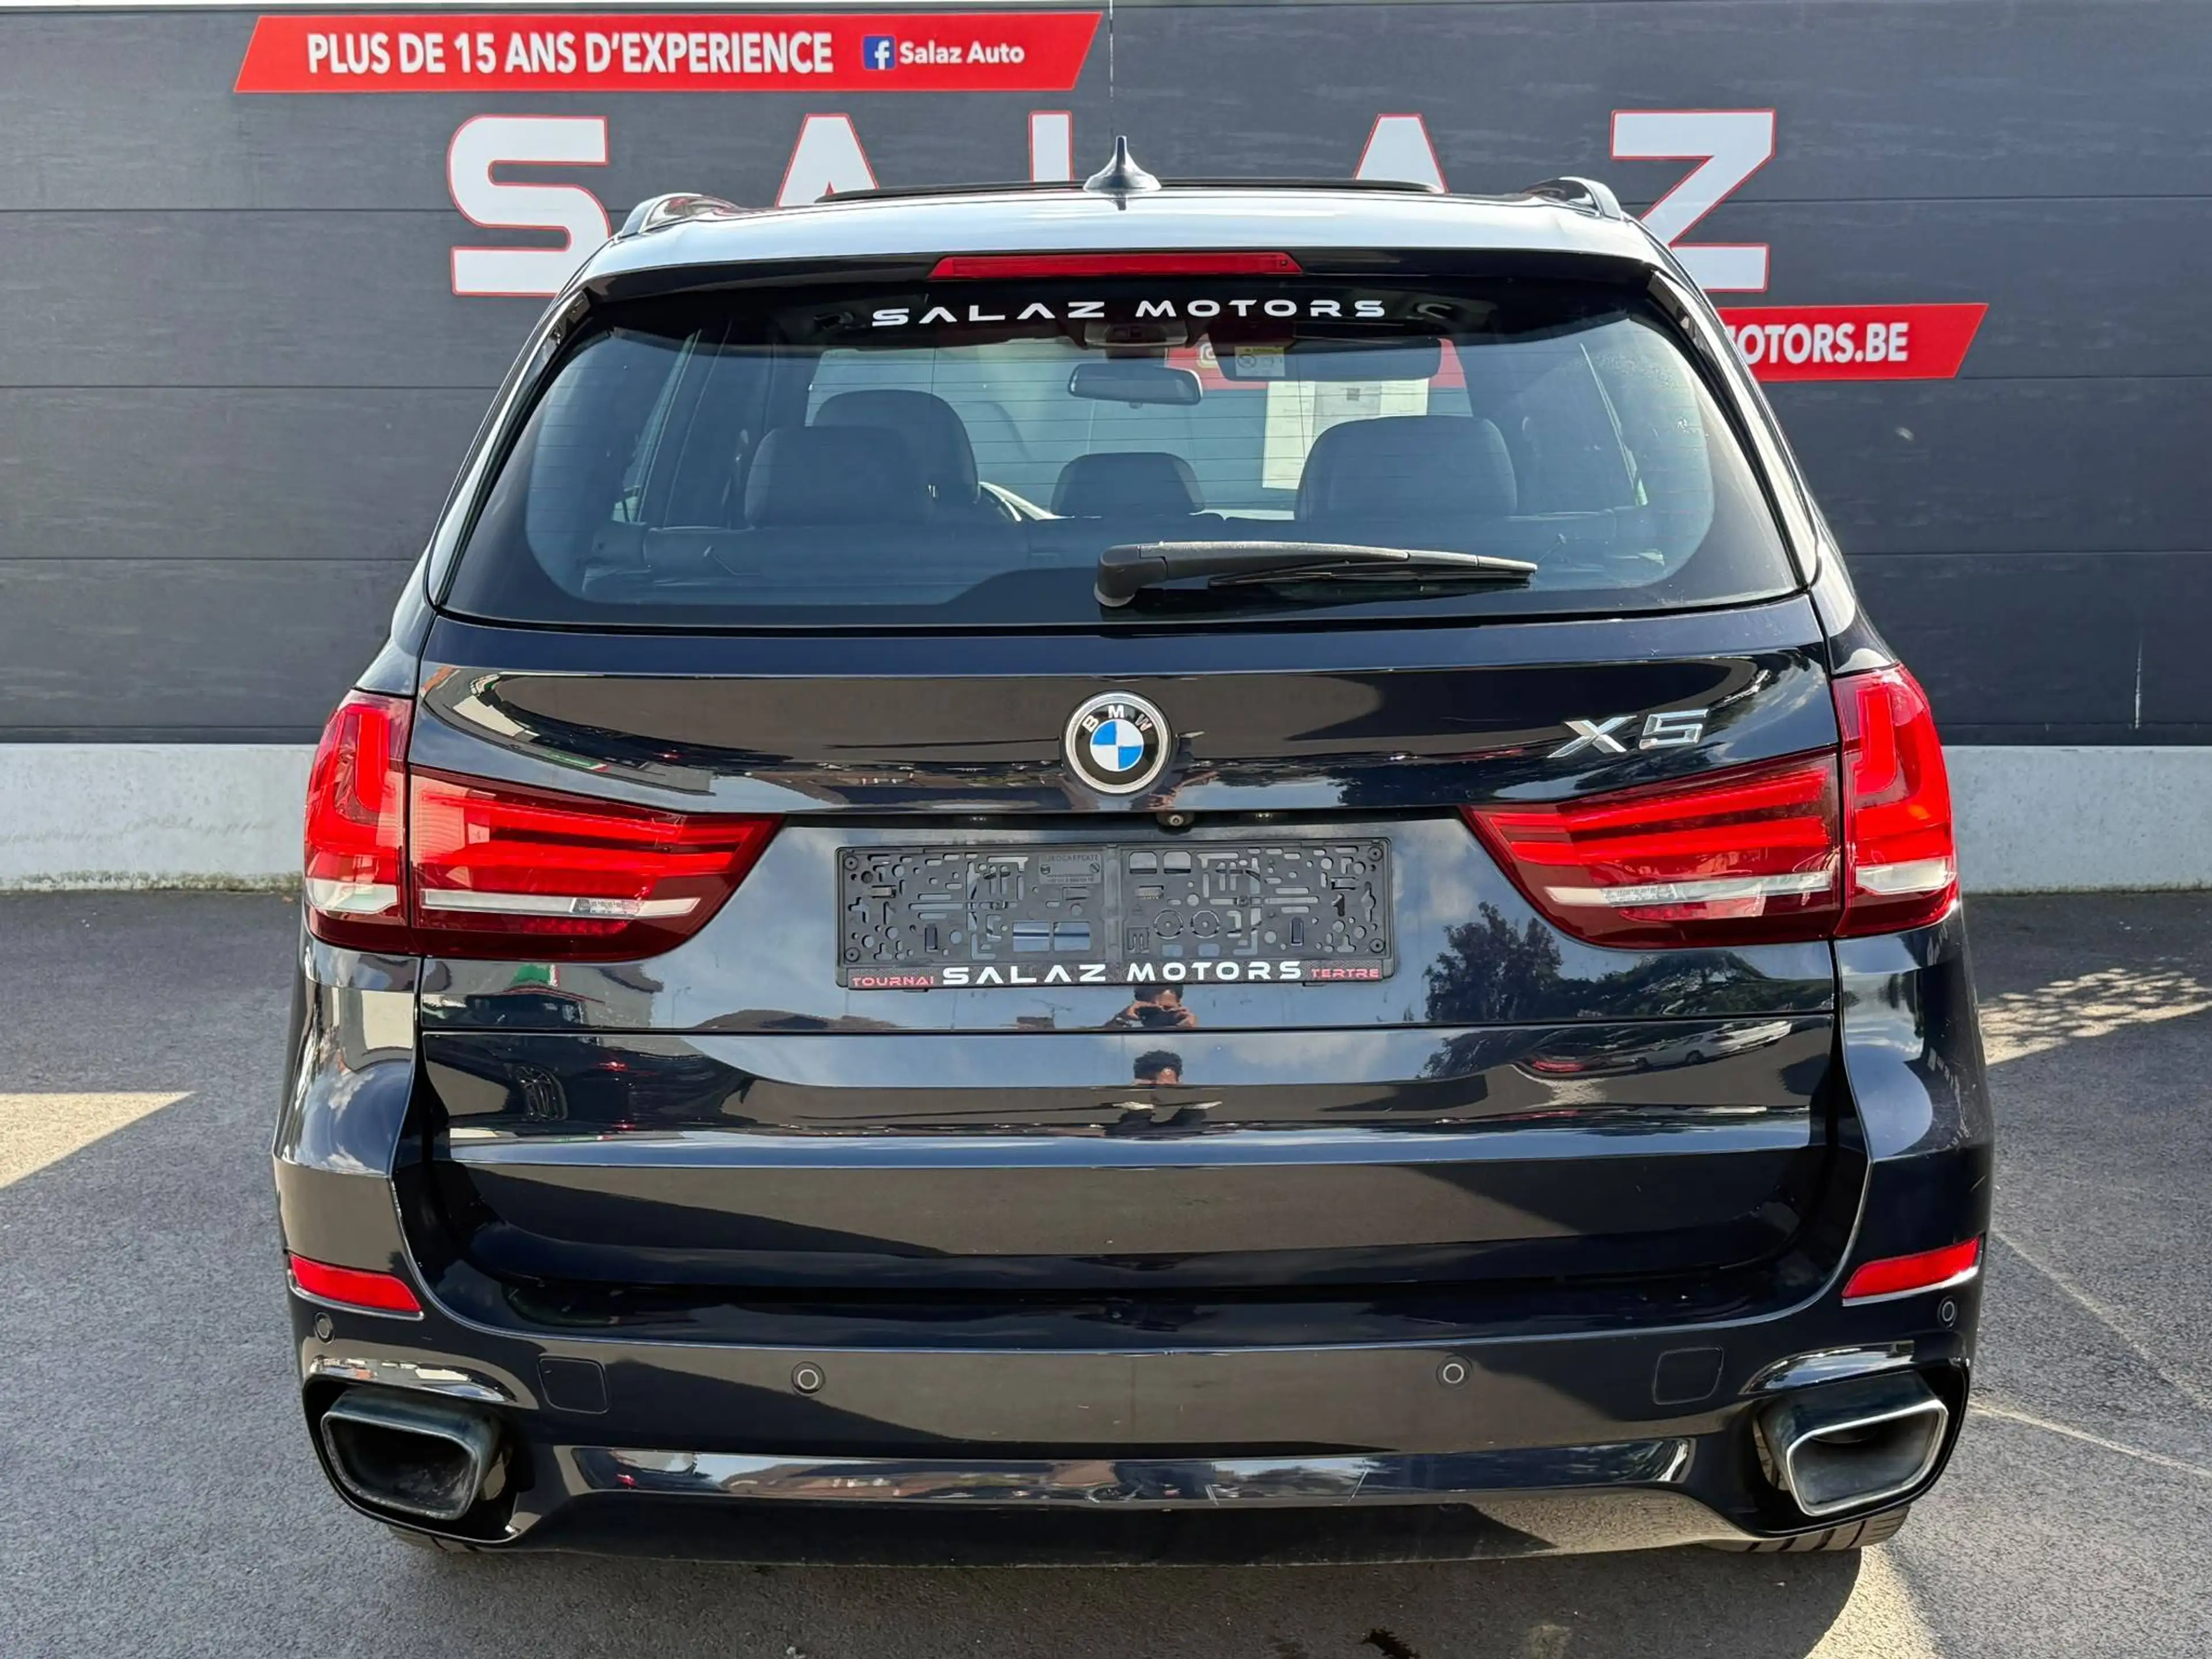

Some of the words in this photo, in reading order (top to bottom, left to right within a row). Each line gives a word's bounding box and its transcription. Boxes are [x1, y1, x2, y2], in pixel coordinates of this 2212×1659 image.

[306, 32, 391, 74] PLUS
[399, 33, 446, 73] DE
[454, 33, 497, 74] 15
[505, 32, 577, 73] ANS
[585, 32, 833, 74] D'EXPERIENCE
[900, 41, 962, 64] Salaz
[967, 41, 1025, 64] Auto
[872, 301, 1105, 327] SALAZ
[1135, 300, 1385, 318] MOTORS
[1725, 322, 1908, 364] OTORS.BE
[1082, 704, 1153, 733] BMW
[1547, 708, 1710, 759] X5
[852, 976, 934, 988] TOURNAI
[942, 964, 1106, 985] SALAZ
[1126, 961, 1301, 982] MOTORS
[1312, 968, 1380, 980] TERTRE
